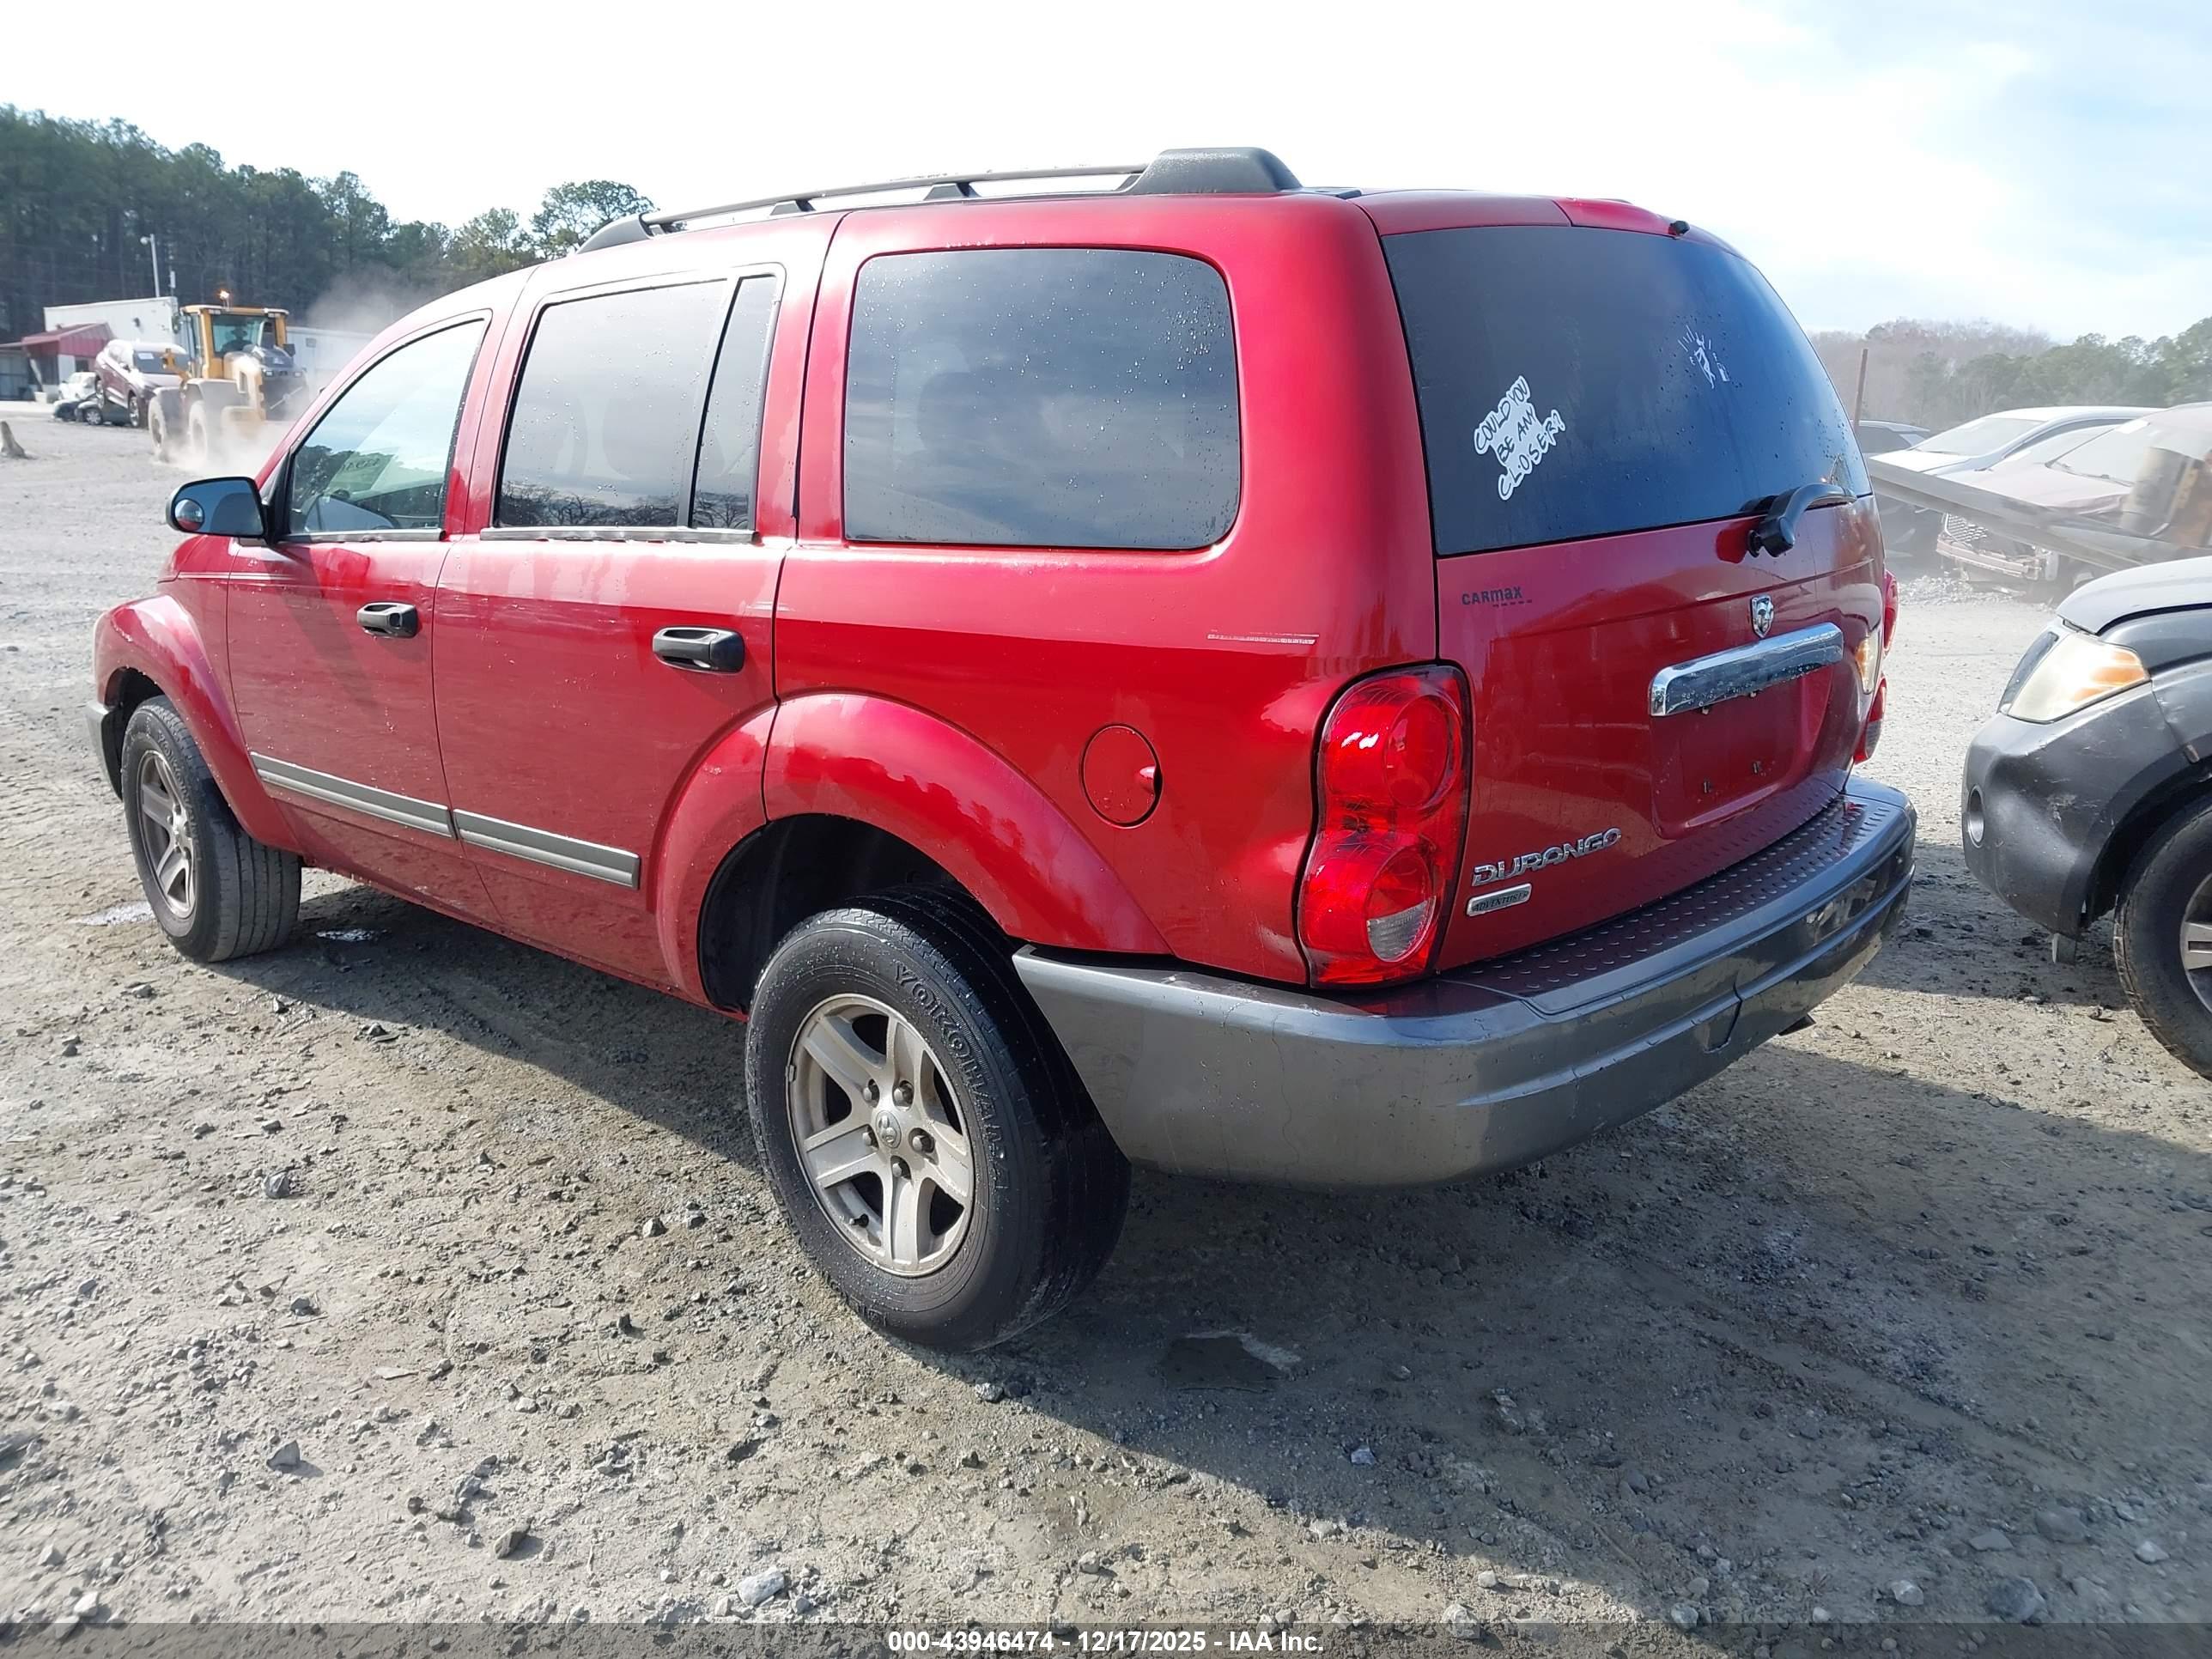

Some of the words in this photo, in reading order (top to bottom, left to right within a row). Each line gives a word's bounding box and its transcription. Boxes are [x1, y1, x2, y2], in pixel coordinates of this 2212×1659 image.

[1476, 400, 1511, 451] COULD
[1508, 378, 1529, 406] YOU
[1497, 435, 1515, 463] BE
[1516, 406, 1538, 441] ANY
[1472, 827, 1621, 887] DURANGO
[894, 960, 1010, 1190] YOKOHAMA
